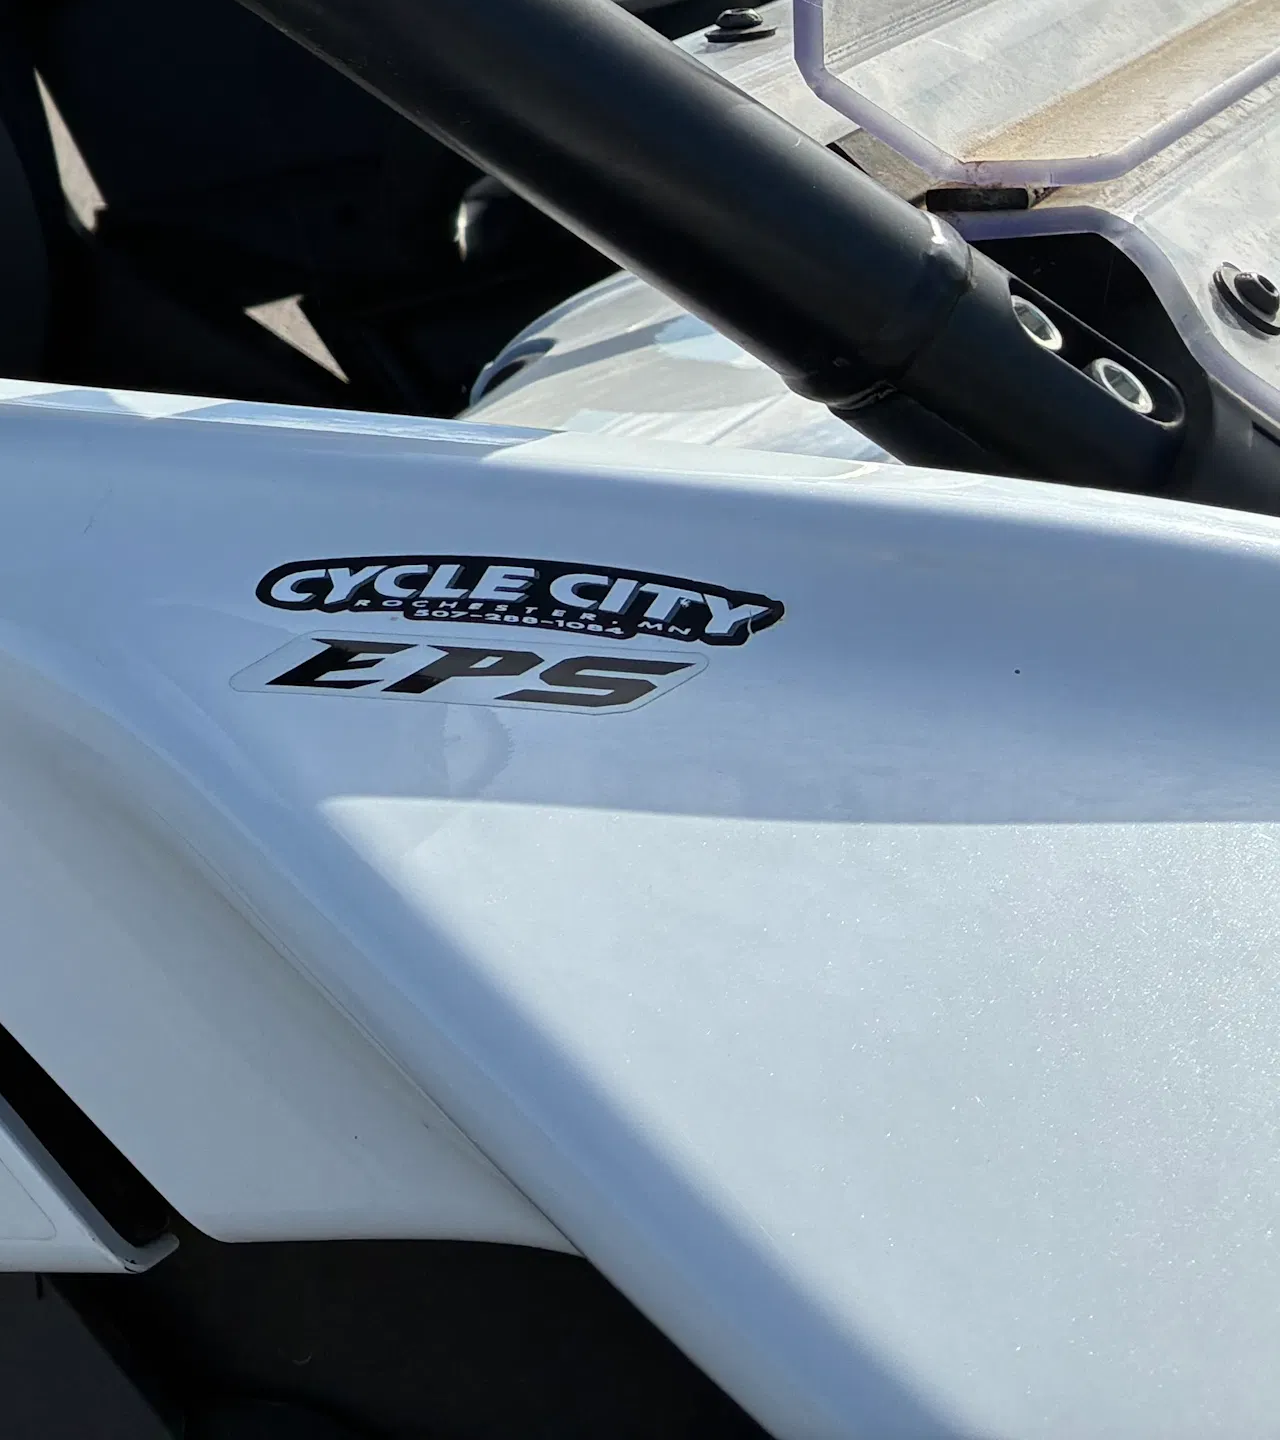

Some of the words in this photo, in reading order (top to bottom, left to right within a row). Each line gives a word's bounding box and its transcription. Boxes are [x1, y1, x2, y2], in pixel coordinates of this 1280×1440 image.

[269, 563, 540, 607] CYCLE
[548, 573, 771, 638] CITY
[413, 609, 625, 636] 507-288-1084
[637, 621, 692, 636] MN
[265, 638, 696, 708] EPS
